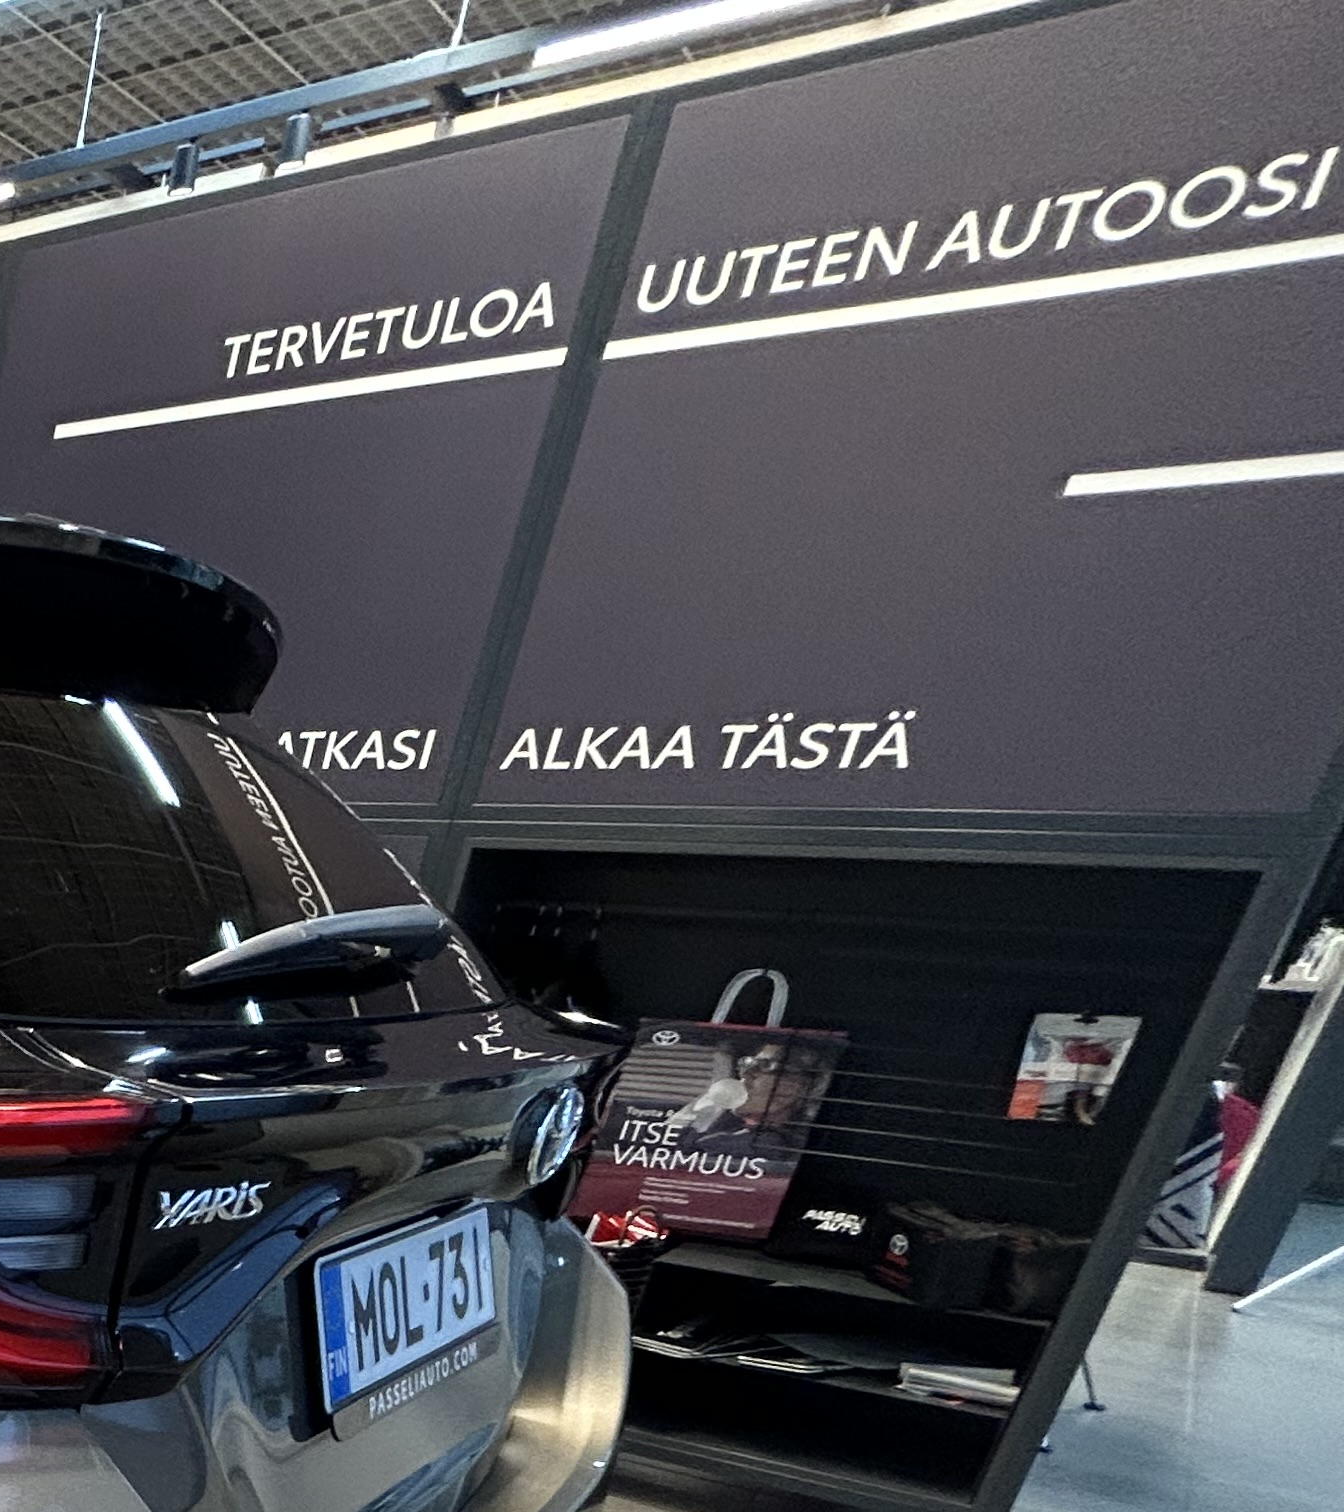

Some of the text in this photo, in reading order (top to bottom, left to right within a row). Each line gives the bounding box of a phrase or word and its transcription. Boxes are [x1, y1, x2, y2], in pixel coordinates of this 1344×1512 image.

[223, 145, 1341, 379] TERVETULOA UUTEEN AUTOOSI
[500, 725, 695, 772] ALKAA
[719, 709, 917, 770] TÄSTÄ
[613, 1143, 768, 1181] VARMUUS
[618, 1119, 684, 1147] ITSE
[350, 1225, 484, 1372] MOL-731
[327, 1346, 350, 1382] FIN
[367, 1341, 480, 1420] PASSELIAUTO.COM
